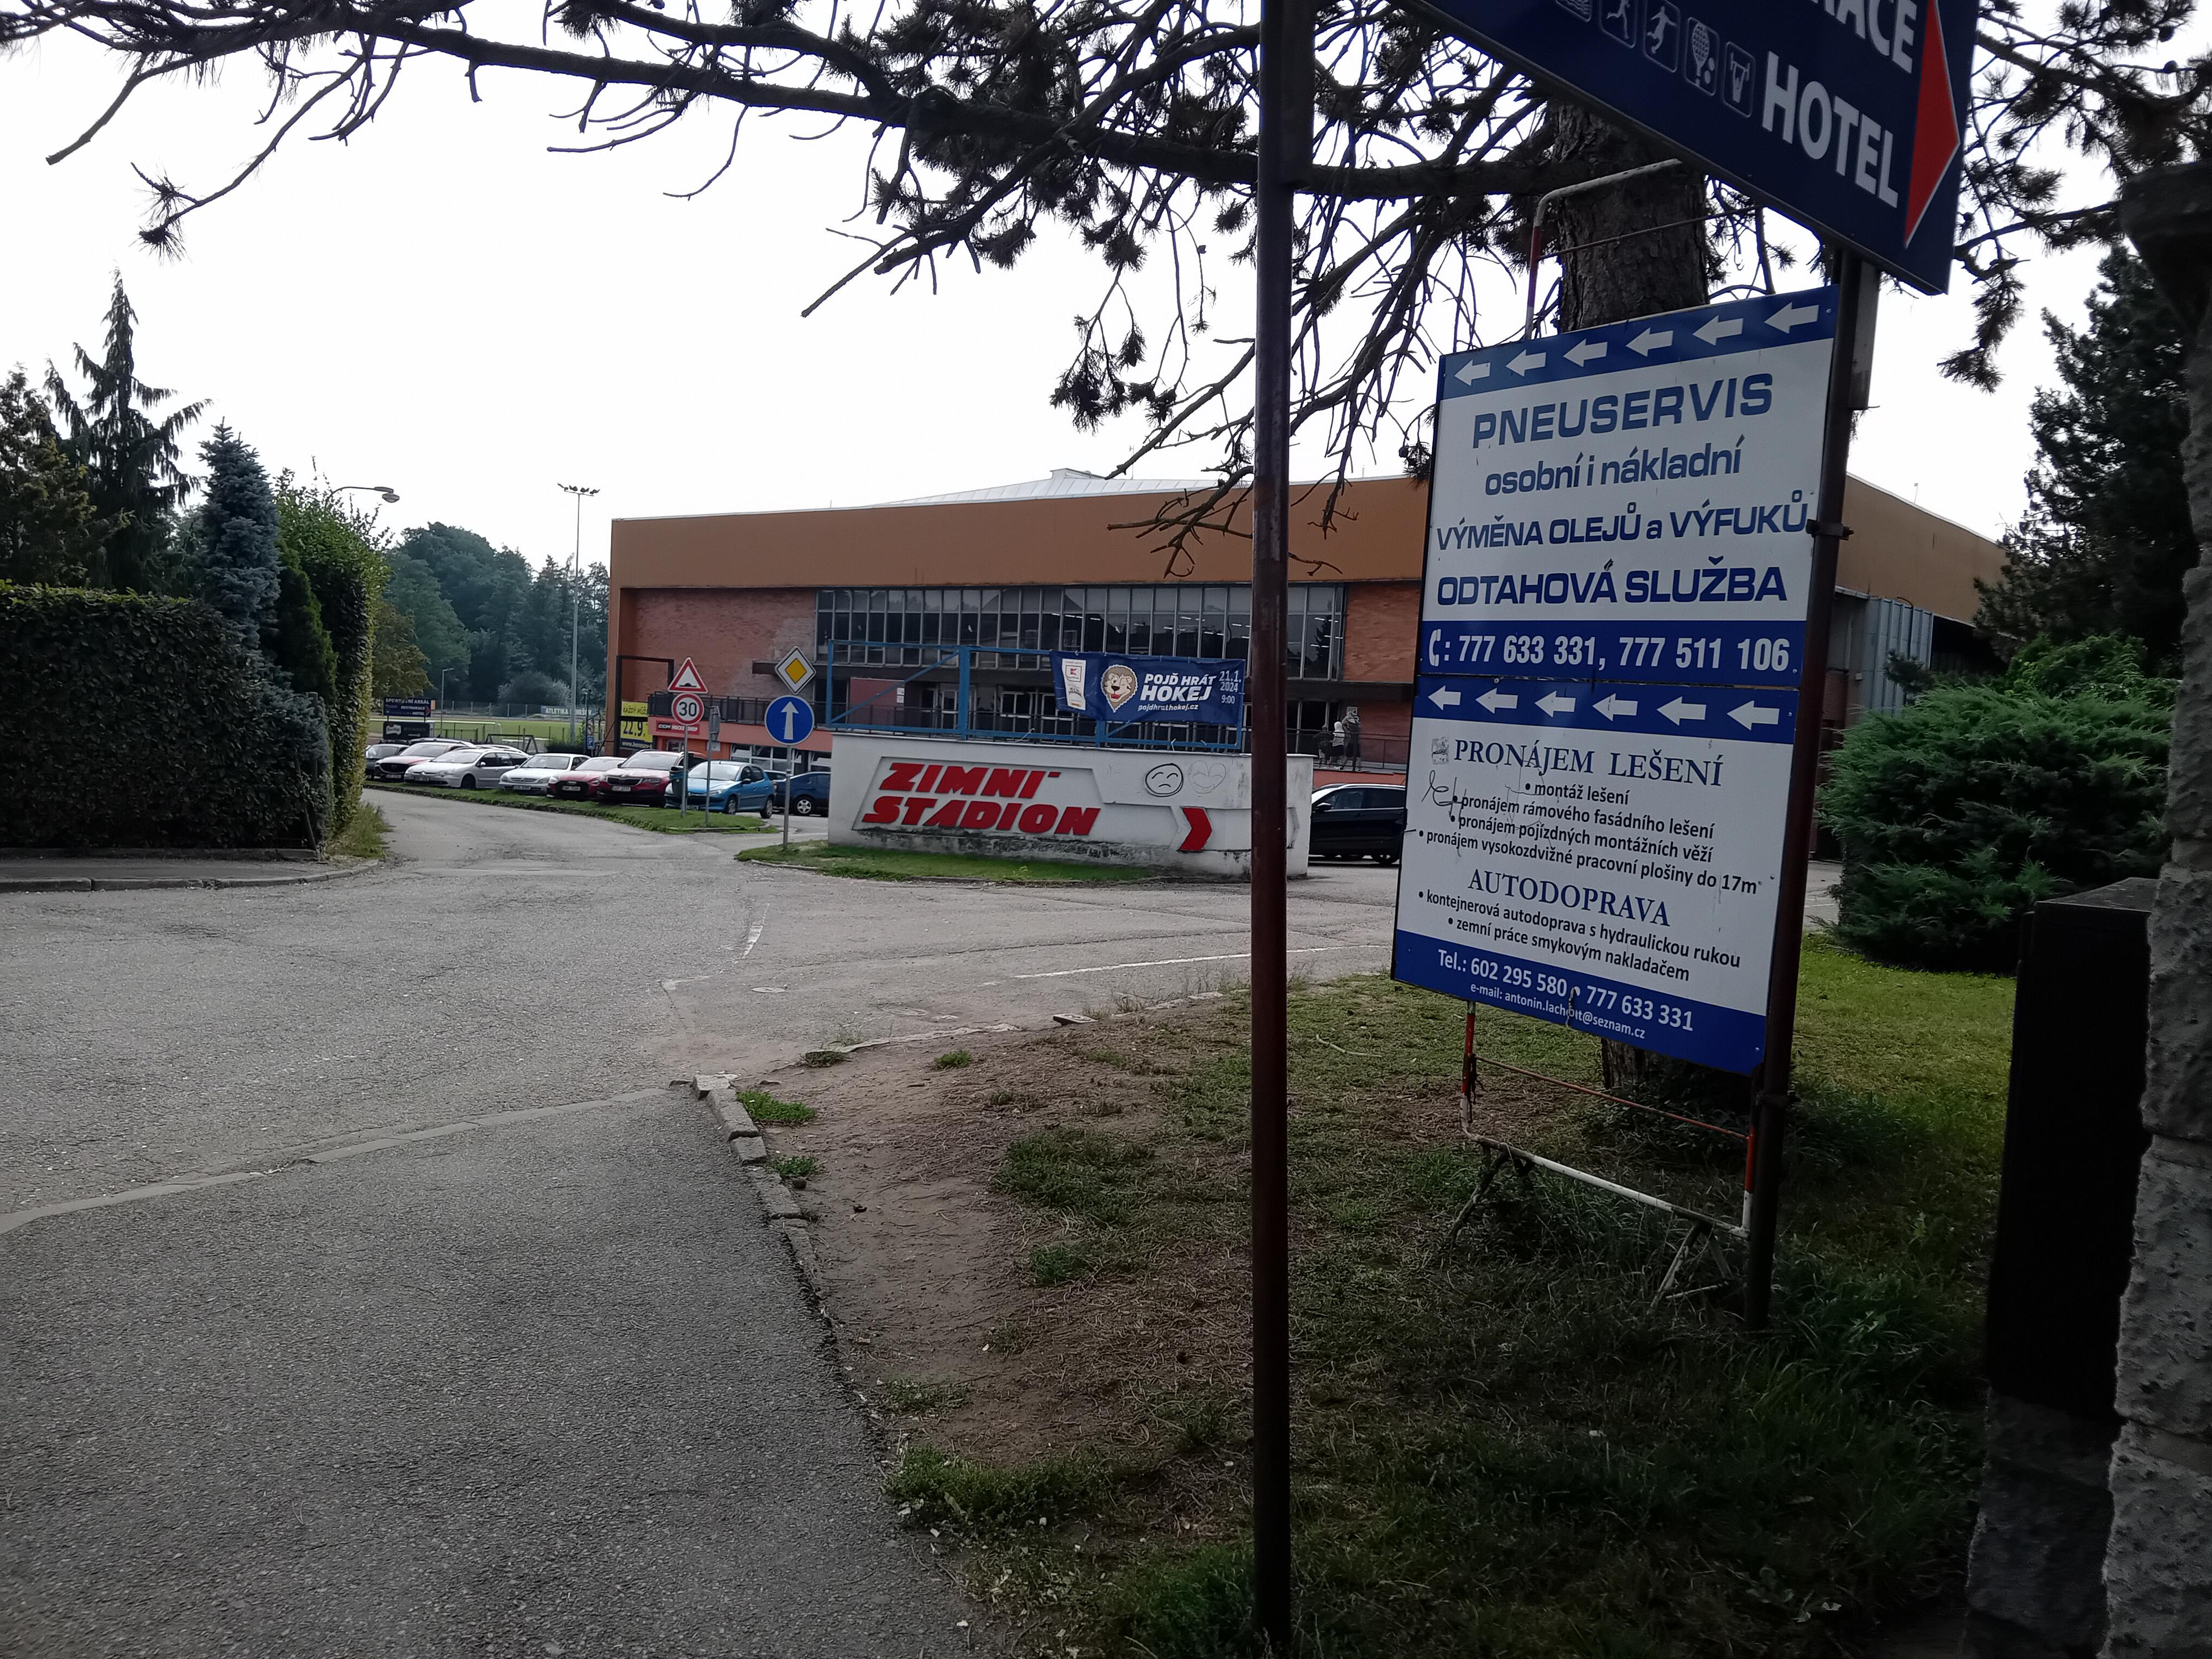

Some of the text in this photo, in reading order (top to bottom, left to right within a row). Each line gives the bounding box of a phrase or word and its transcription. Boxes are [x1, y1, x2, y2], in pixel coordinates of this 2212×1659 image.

[1762, 50, 1898, 209] HOTEL
[1473, 373, 1772, 448] PNEUSERVIS
[1485, 434, 1745, 495] osobní i nákladní
[1437, 489, 1807, 550] VÝMĚNA OLEJŮ a VÝFUKŮ
[1437, 556, 1787, 606] ODTAHOVÁ SLUŽBA
[1459, 635, 1789, 671] 777 633 331, 777 511 106
[1140, 685, 1212, 702] HOKEJ
[1144, 672, 1217, 685] POJĎ HRÁT
[1219, 670, 1241, 682] 21.1.
[1220, 682, 1238, 692] 2024
[679, 702, 697, 717] 30
[1221, 695, 1235, 704] 9:00
[879, 762, 1060, 799] ZIMNÍ
[1454, 739, 1723, 786] PRONÁJEM LEŠENÍ
[1535, 780, 1630, 805] montáž lešení
[862, 795, 1100, 836] STADION
[1462, 796, 1715, 839] pronájem rámového fasádního lešení
[1459, 817, 1713, 863] pronájem pojízdných montážních věží
[1427, 832, 1756, 894] pronájem vysokozdvižné pracovní plošiny do 17m
[1468, 869, 1671, 927] AUTODOPRAVA
[1426, 889, 1741, 968] kontejnerová autodoprava s hydraulickou rukou
[1457, 918, 1690, 982] zemní práce smykovým nakladačem
[1438, 949, 1693, 1031] Tel.: 602 295 580 777 633 331
[1470, 982, 1503, 999] e-mail:
